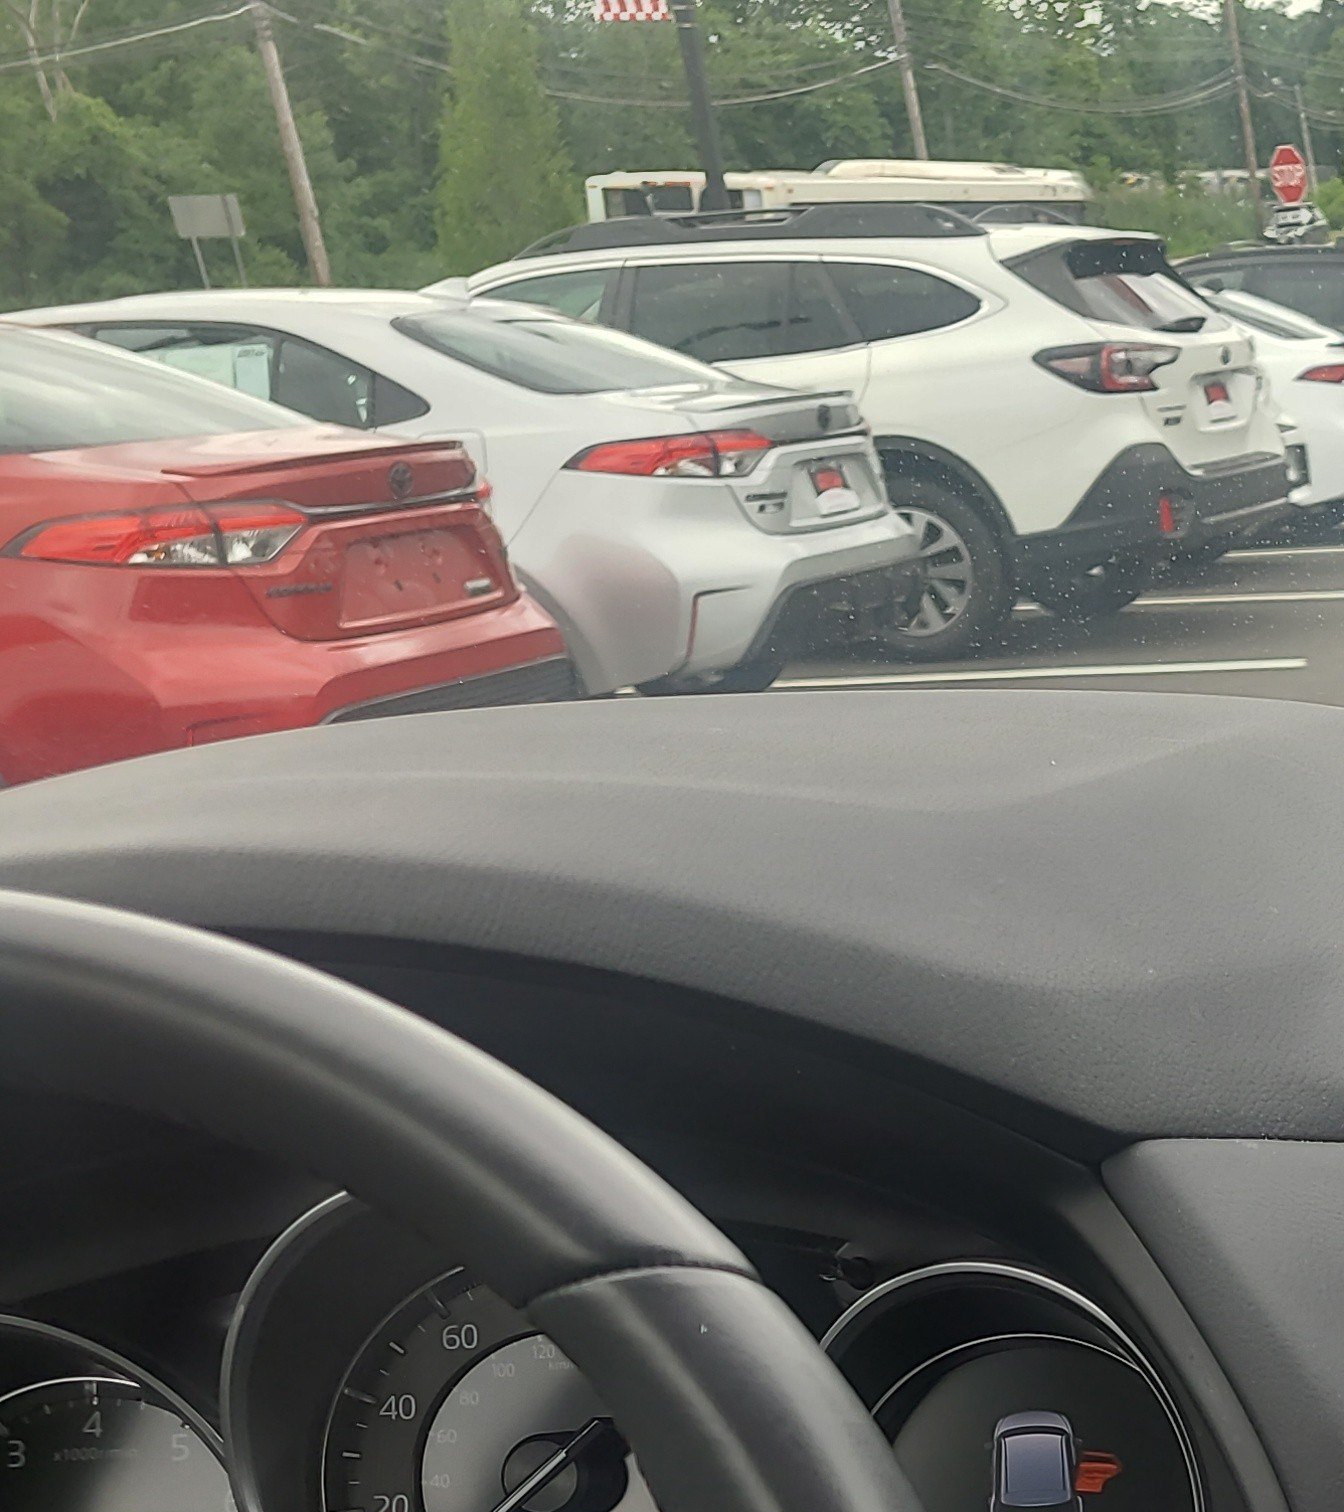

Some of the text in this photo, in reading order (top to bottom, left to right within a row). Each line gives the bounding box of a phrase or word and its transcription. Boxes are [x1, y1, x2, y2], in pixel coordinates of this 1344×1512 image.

[1273, 164, 1304, 187] STOP
[442, 1325, 478, 1350] 60
[532, 1344, 556, 1359] 120
[492, 1362, 515, 1378] 100
[379, 1394, 416, 1420] 40
[82, 1411, 103, 1438] 4
[6, 1440, 26, 1468] 3
[171, 1434, 190, 1461] 5
